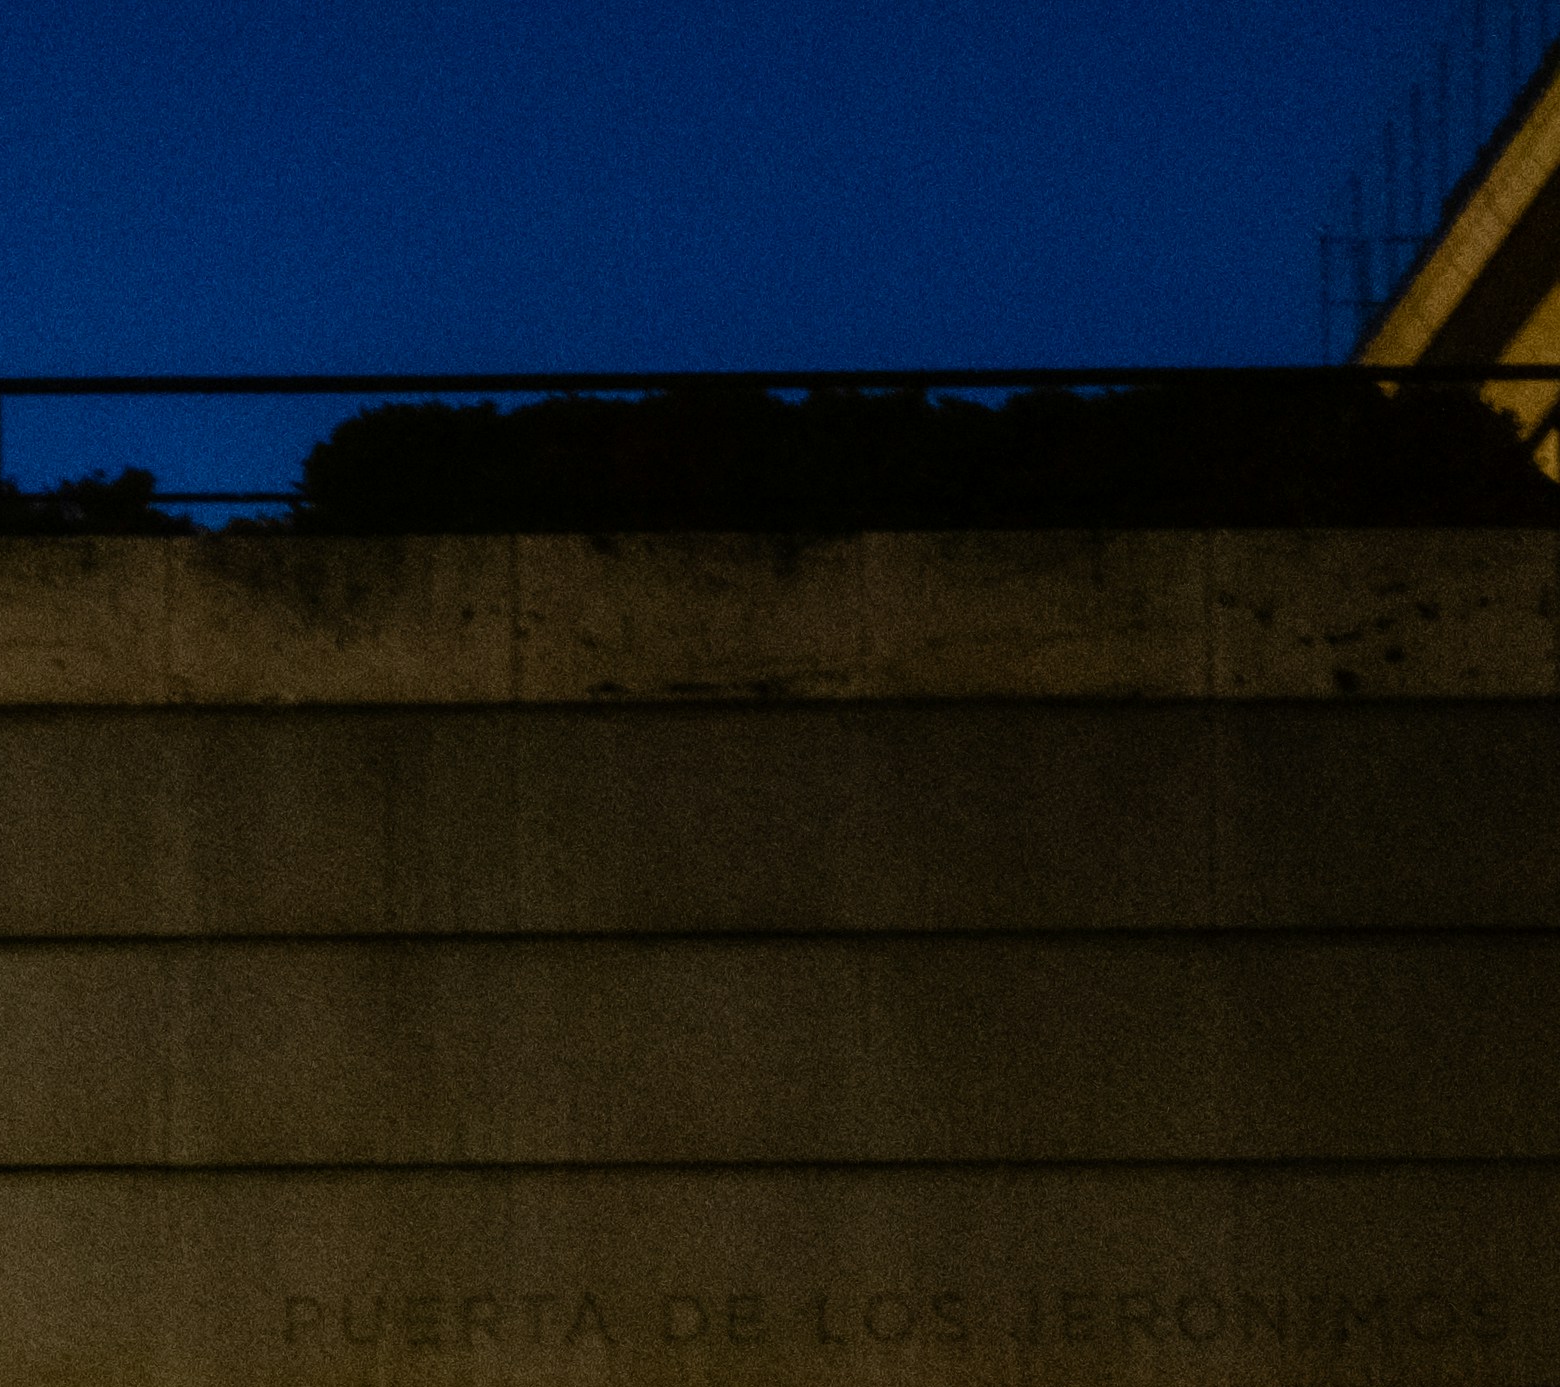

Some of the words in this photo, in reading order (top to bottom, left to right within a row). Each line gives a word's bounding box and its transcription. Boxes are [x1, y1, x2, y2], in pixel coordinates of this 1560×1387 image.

[282, 1292, 617, 1348] PUERTA
[661, 1292, 767, 1347] DE
[814, 1290, 970, 1346] LOS
